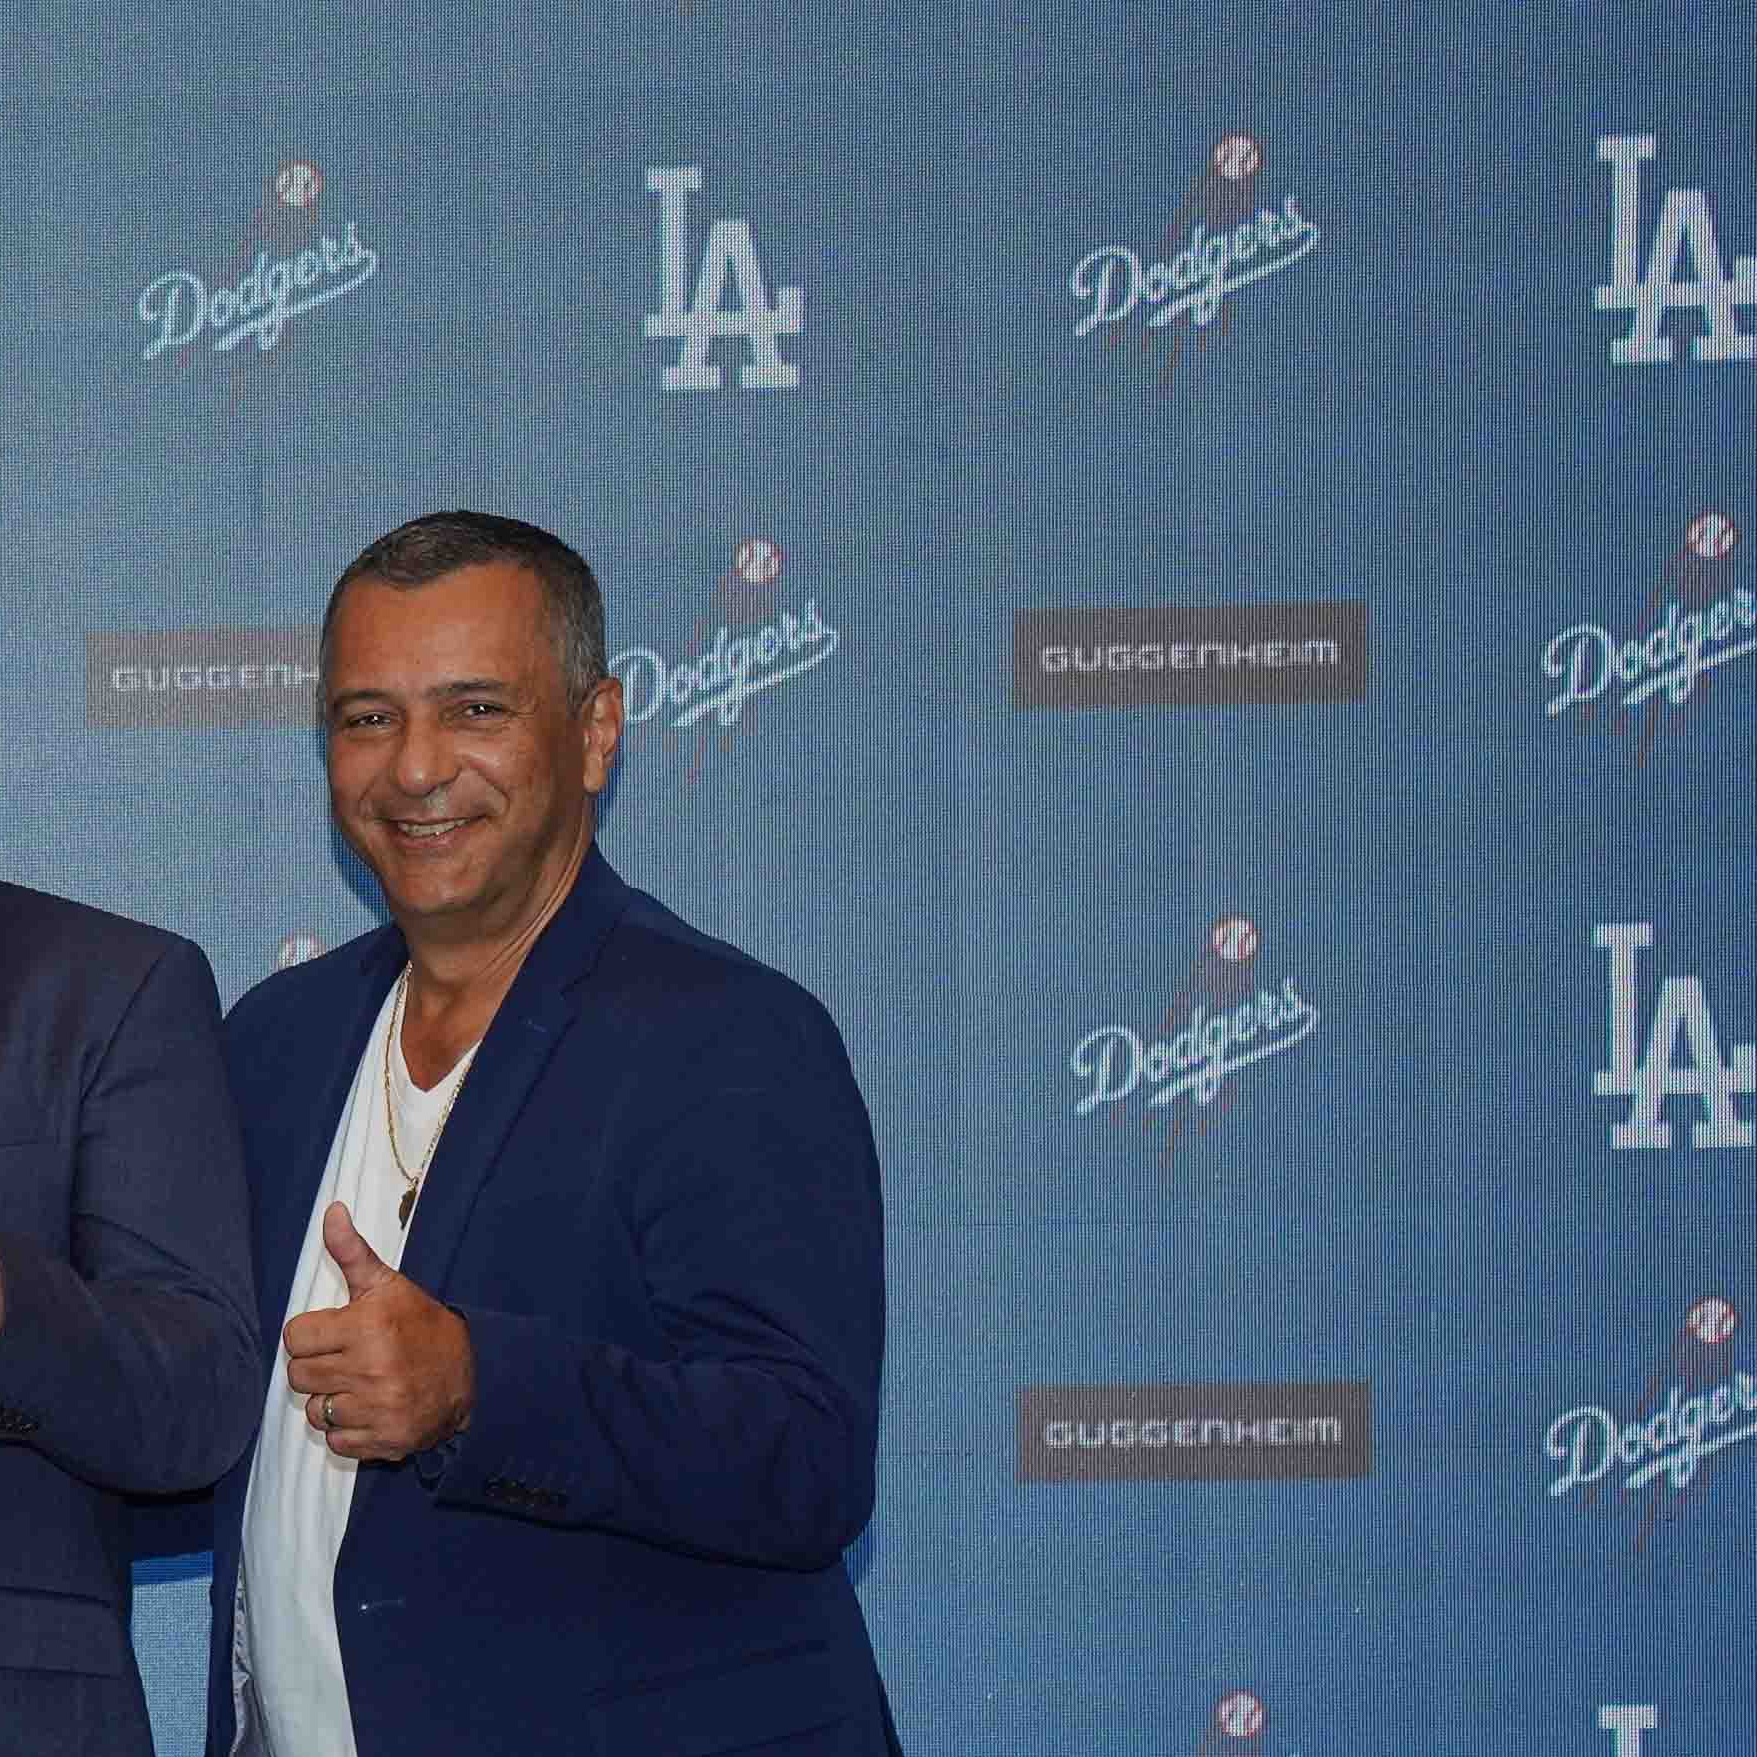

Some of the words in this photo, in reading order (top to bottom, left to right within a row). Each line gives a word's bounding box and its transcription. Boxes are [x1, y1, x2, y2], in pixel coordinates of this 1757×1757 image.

[139, 225, 377, 359] Dodgers
[647, 168, 802, 389] LA
[1071, 199, 1316, 336] Dodgers
[1597, 136, 1757, 362] LA
[110, 663, 321, 693] GUGGENH
[608, 599, 838, 727] Dodgers
[1039, 639, 1339, 673] GUGGENHEIM
[1543, 590, 1757, 715] Dodger
[1073, 982, 1317, 1112] Dodgers
[1595, 923, 1757, 1148] LA
[1044, 1417, 1342, 1449] GUGGENHEIM
[1547, 1375, 1757, 1495] Dodger
